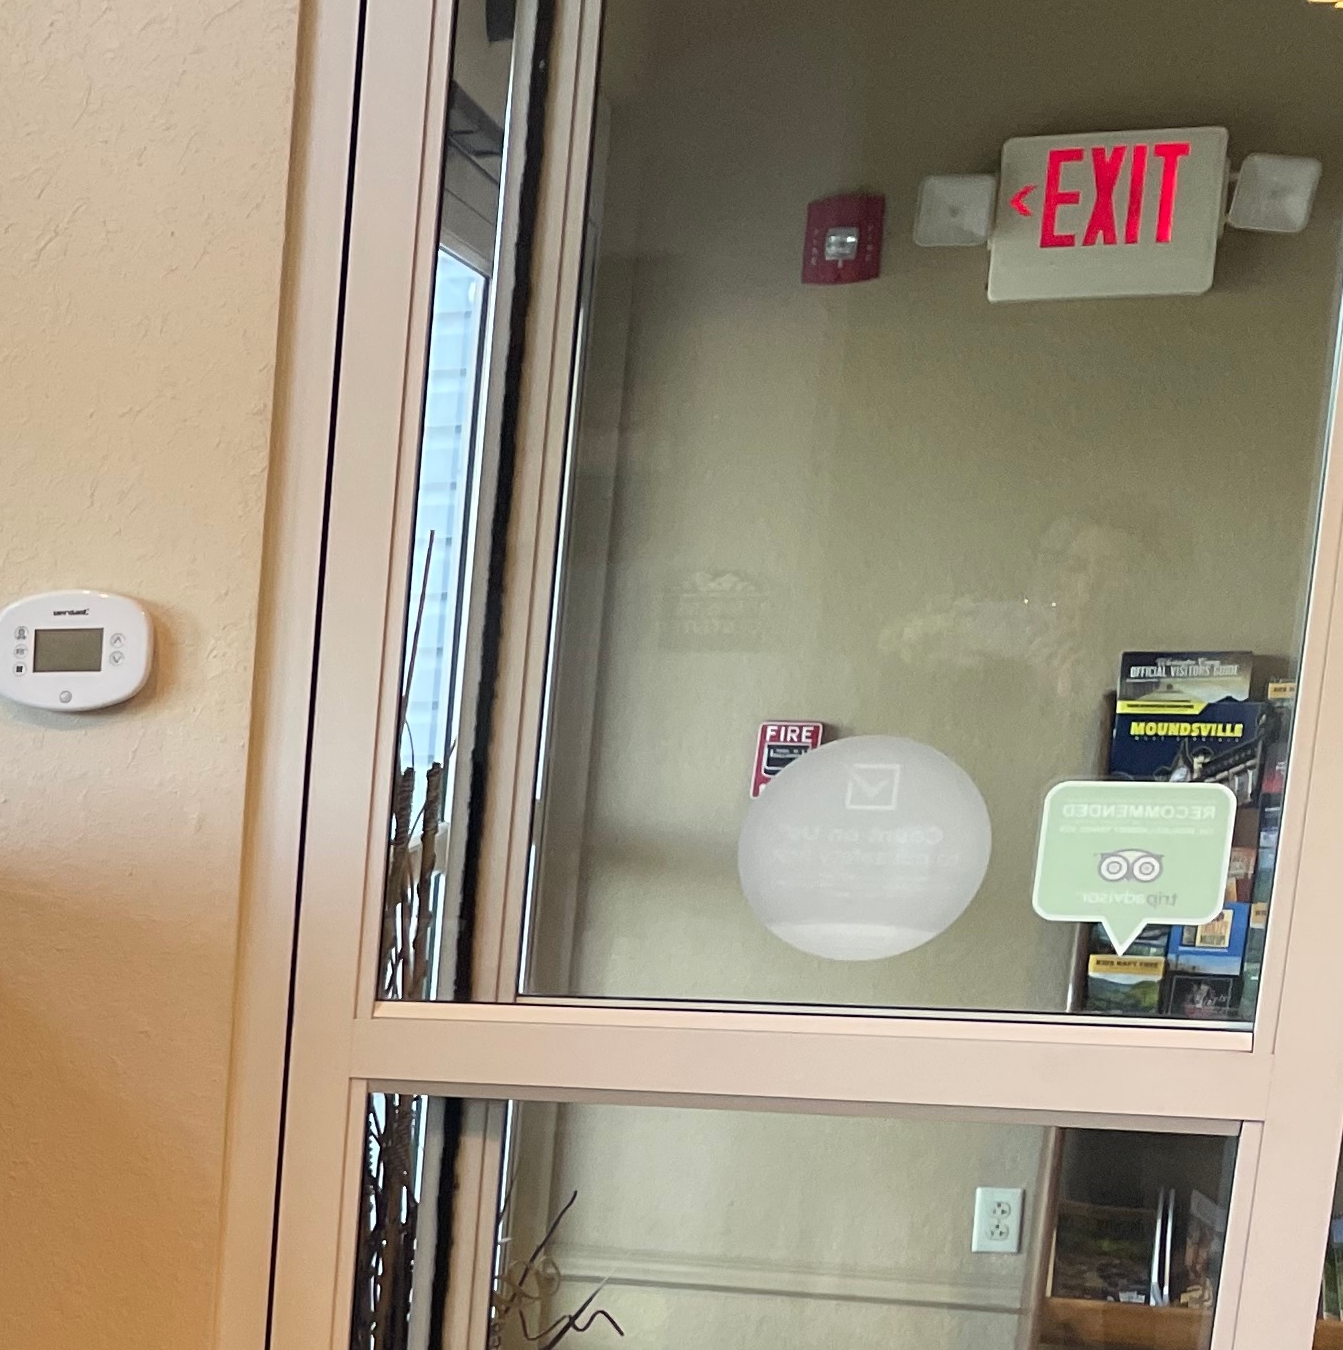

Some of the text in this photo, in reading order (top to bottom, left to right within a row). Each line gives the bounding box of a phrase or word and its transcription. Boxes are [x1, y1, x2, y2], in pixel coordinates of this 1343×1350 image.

[1039, 141, 1190, 249] EXIT
[1130, 666, 1166, 678] OFFICIAL
[765, 726, 814, 743] FIRE
[1130, 721, 1244, 737] MOUNDSVILLE
